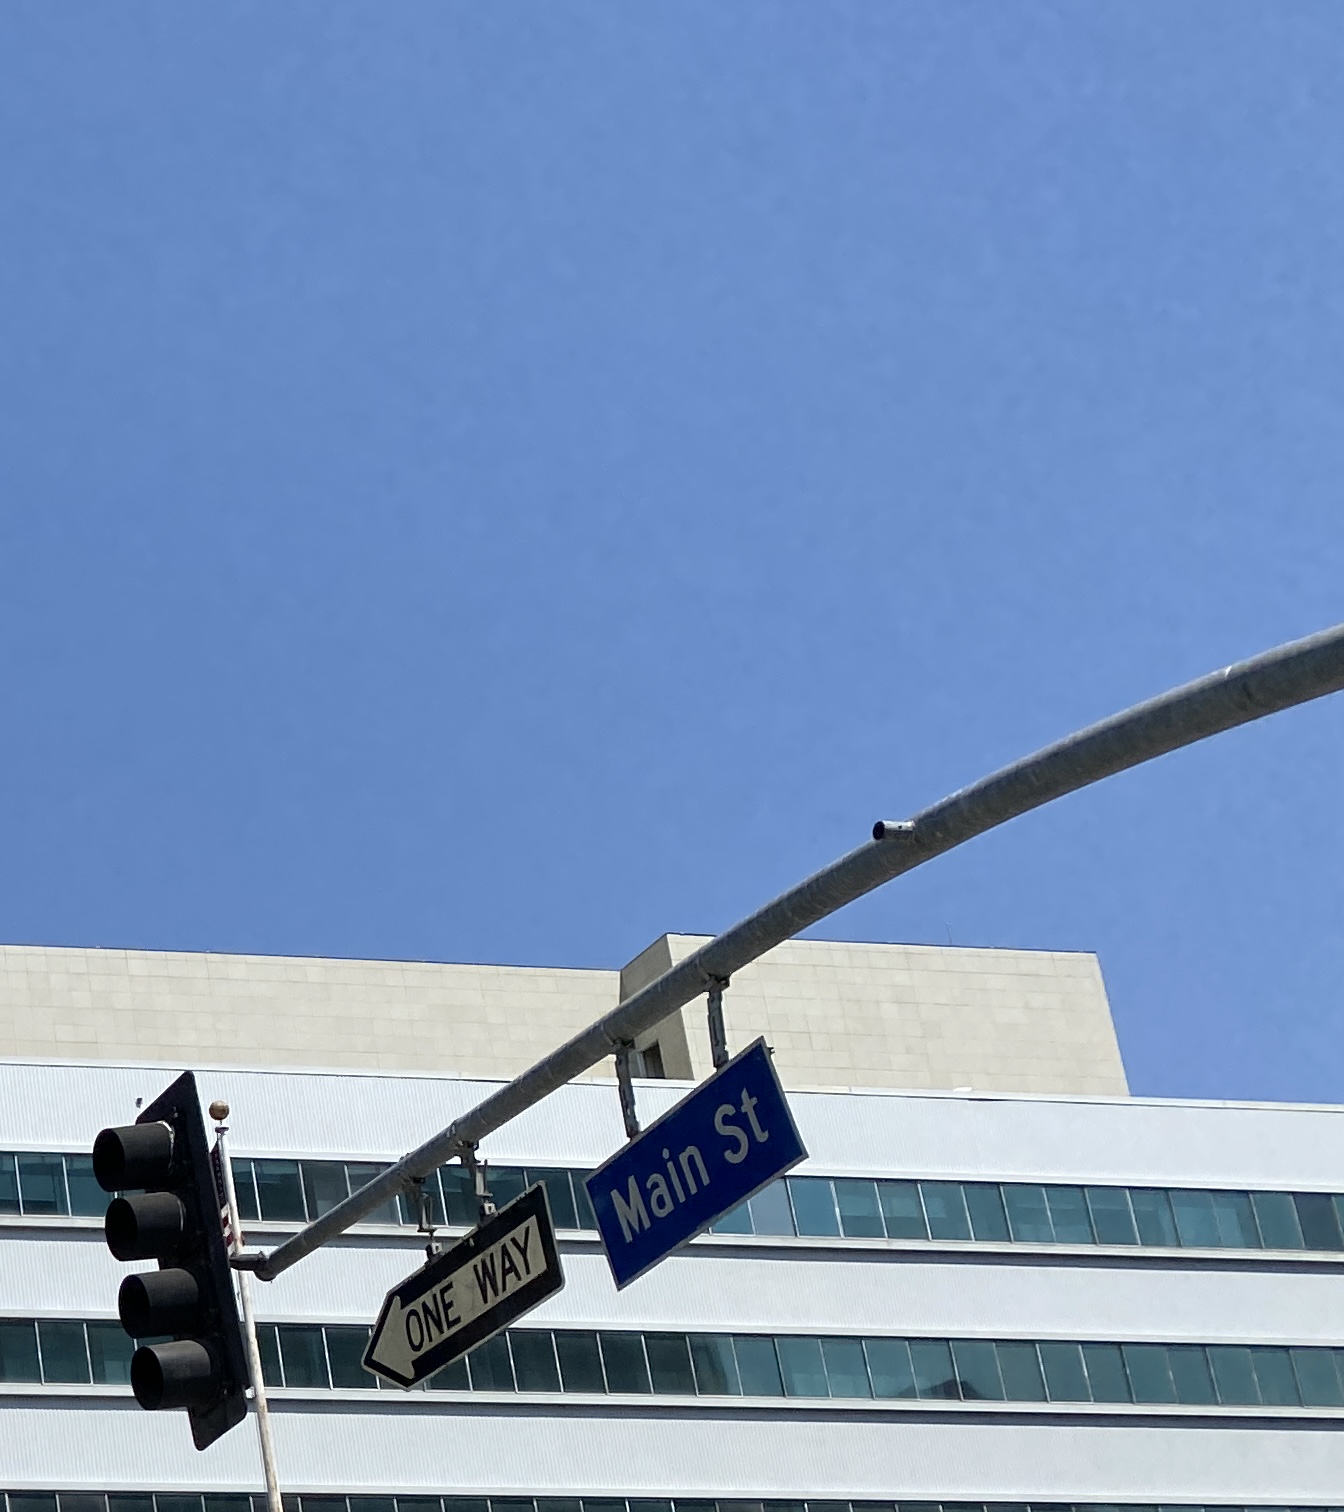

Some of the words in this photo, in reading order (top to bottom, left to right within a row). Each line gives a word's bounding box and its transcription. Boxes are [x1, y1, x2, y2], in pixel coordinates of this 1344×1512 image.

[610, 1145, 711, 1244] Main
[714, 1087, 769, 1165] St
[405, 1280, 463, 1352] ONE
[473, 1226, 534, 1305] WAY
